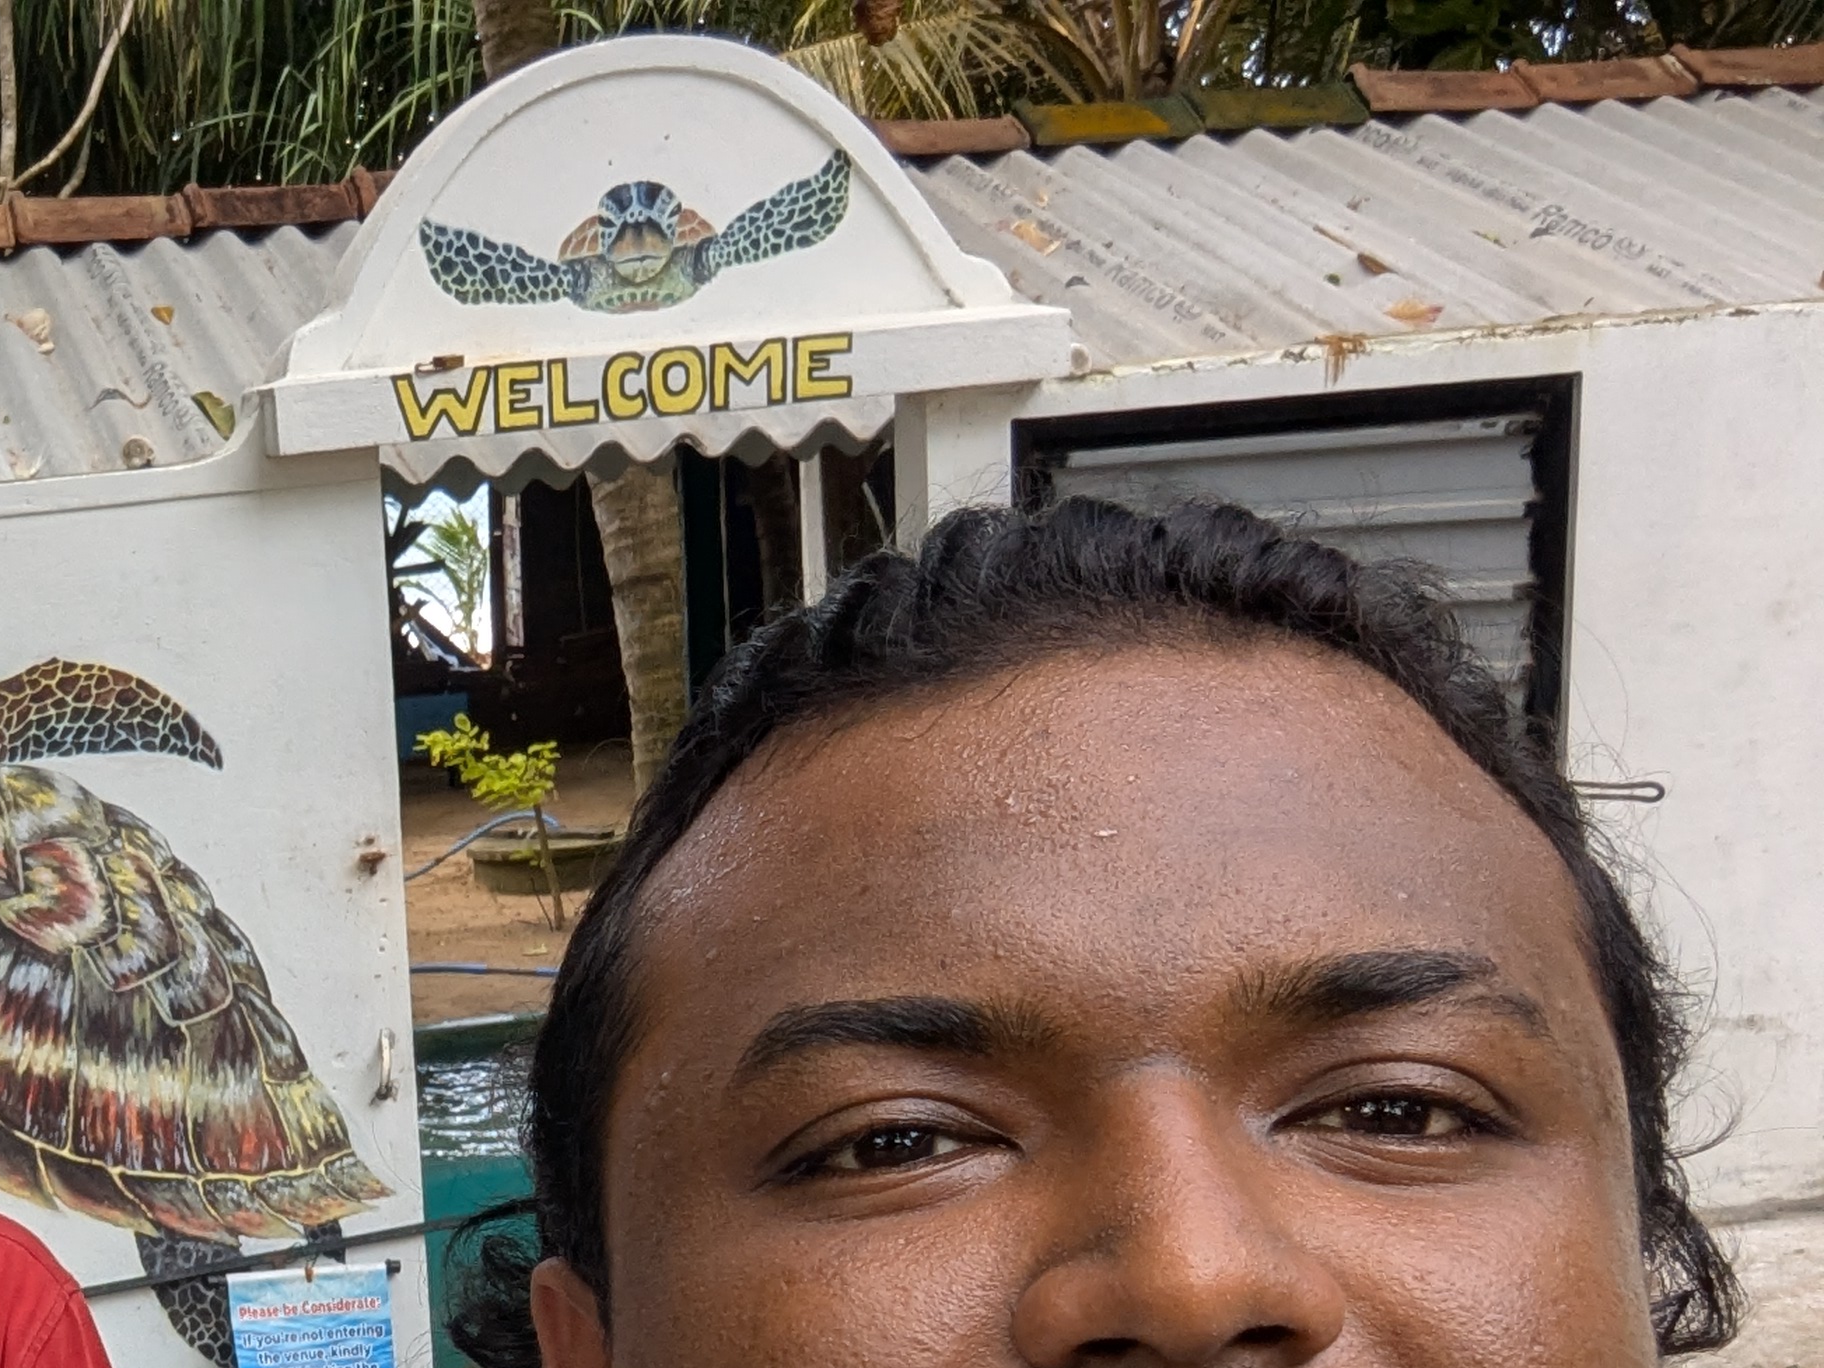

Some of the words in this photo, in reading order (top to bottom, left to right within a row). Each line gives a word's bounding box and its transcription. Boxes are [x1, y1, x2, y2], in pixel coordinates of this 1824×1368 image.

[391, 332, 854, 441] WELCOME
[239, 1306, 279, 1320] Please
[283, 1303, 298, 1315] be
[256, 1332, 297, 1348] you're
[302, 1329, 323, 1341] not
[327, 1323, 383, 1338] entering
[259, 1353, 280, 1365] the
[331, 1344, 372, 1359] kindly
